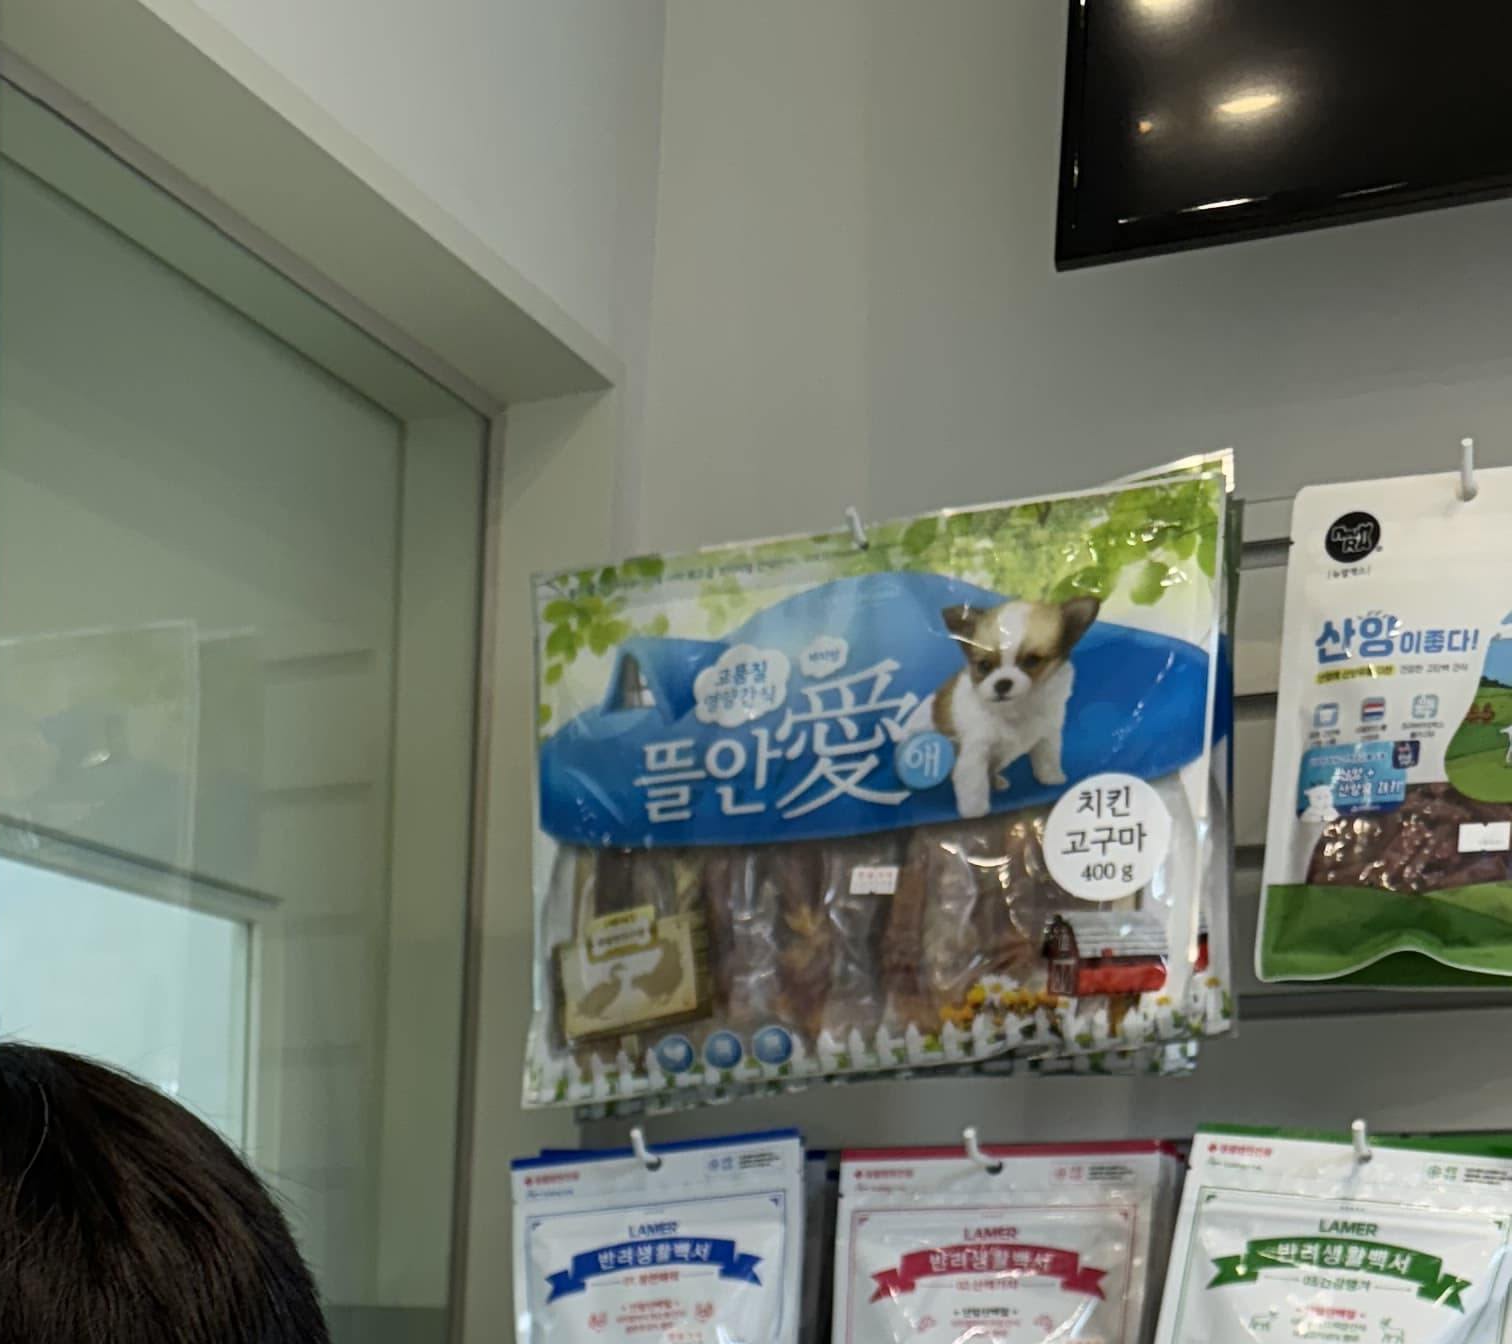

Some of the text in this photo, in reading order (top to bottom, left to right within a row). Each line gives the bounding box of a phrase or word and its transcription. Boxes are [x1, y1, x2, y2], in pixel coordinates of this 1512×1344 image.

[713, 659, 768, 687] 고품질
[904, 741, 940, 778] 애
[1076, 785, 1131, 818] 치킨
[1061, 822, 1148, 856] 고구마
[1080, 863, 1134, 882] 400 g
[963, 1226, 1018, 1241] LAMER
[1319, 1218, 1378, 1237] LAMER
[597, 1240, 713, 1270] 반려생활백서
[1276, 1241, 1412, 1275] 반려생활백서
